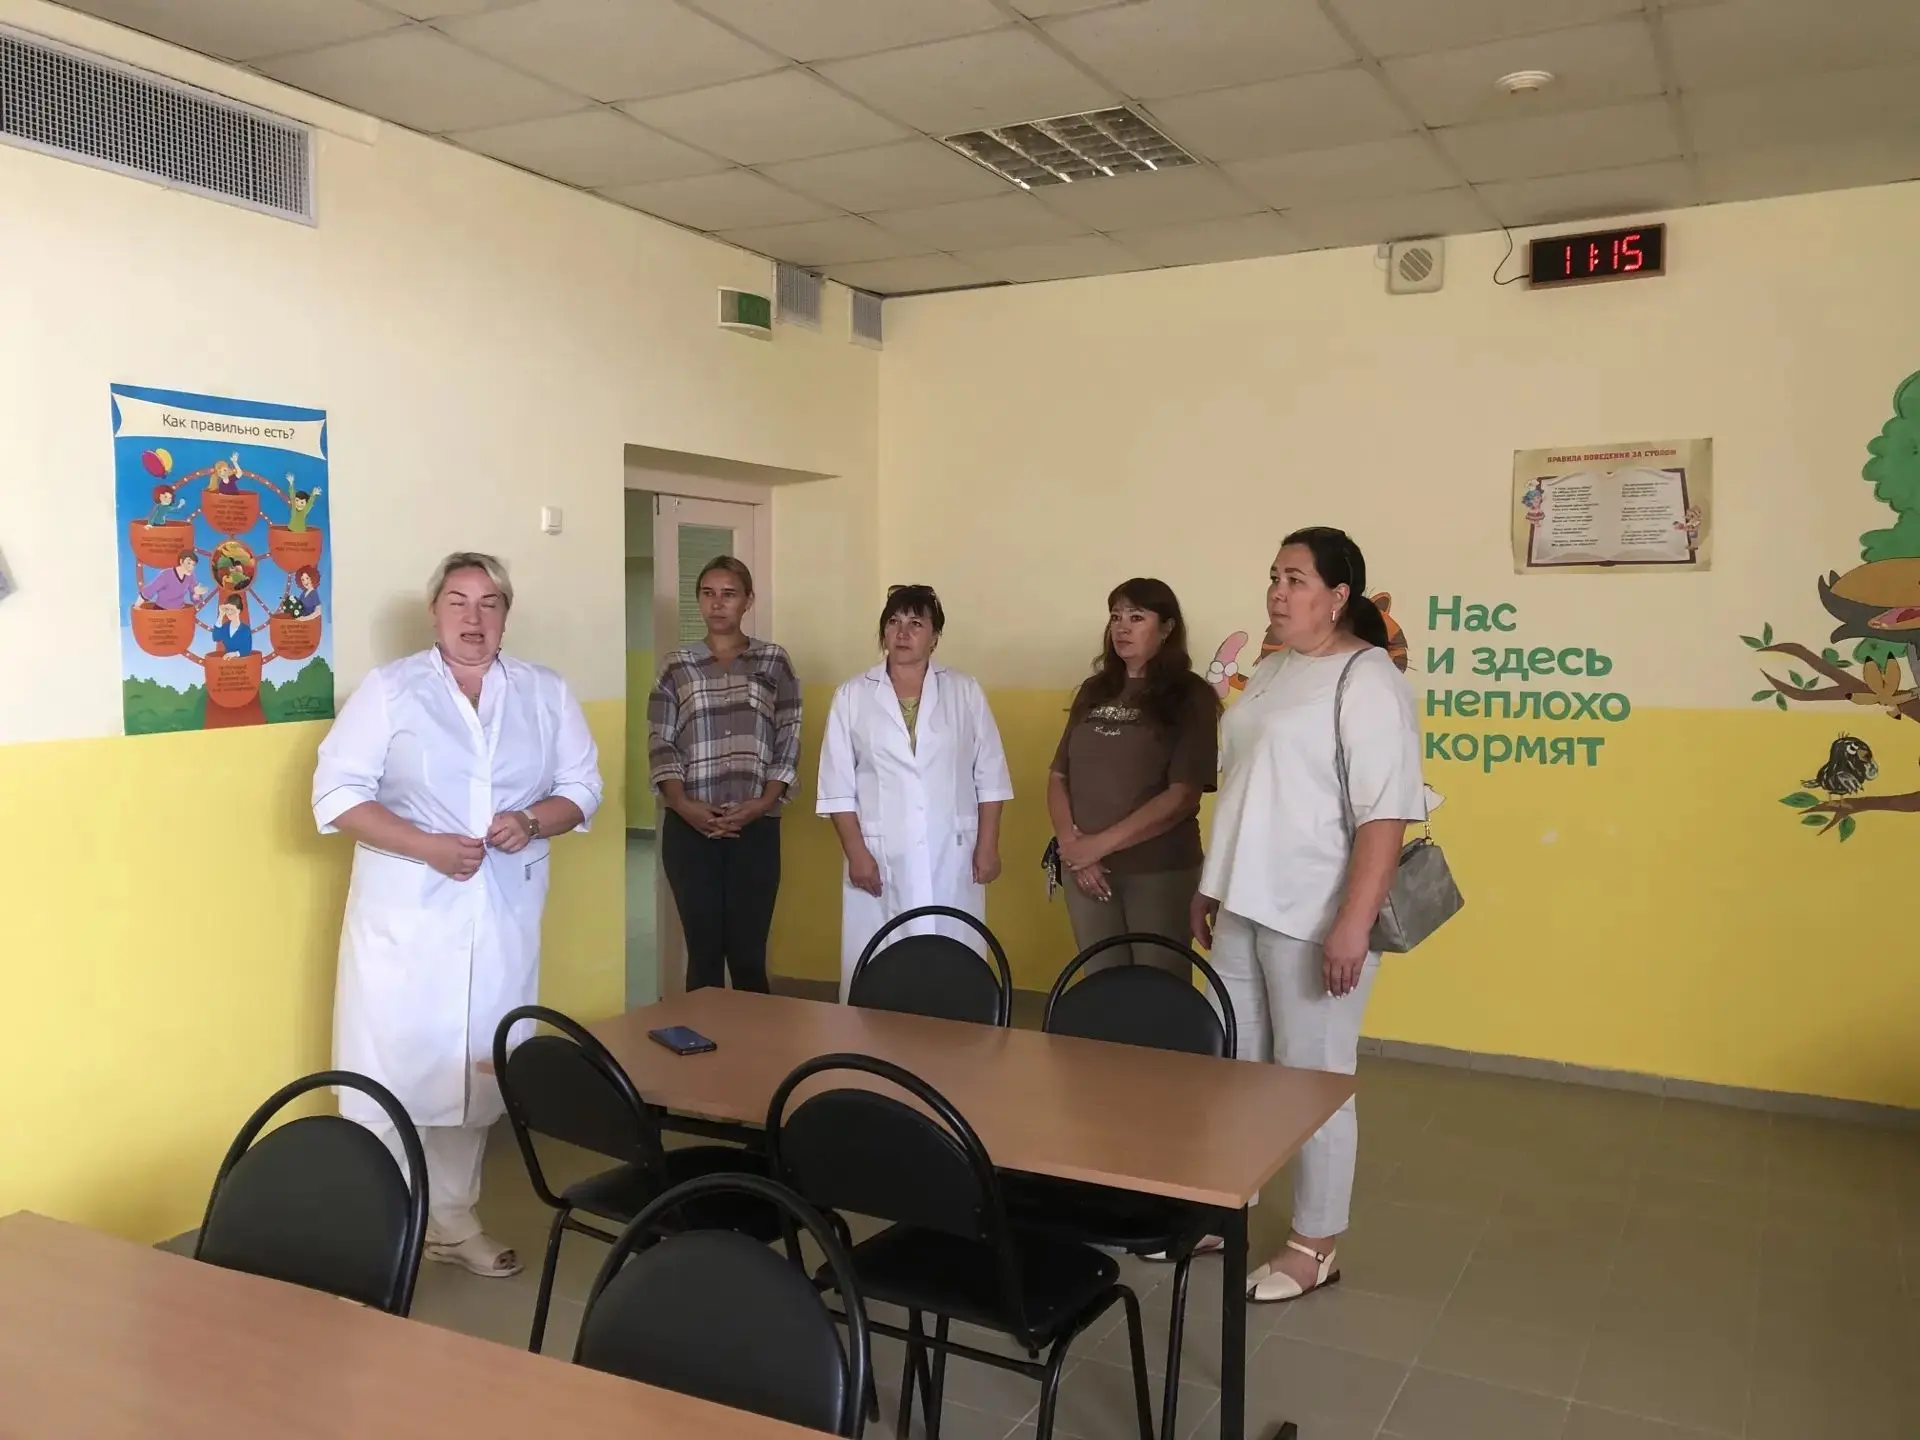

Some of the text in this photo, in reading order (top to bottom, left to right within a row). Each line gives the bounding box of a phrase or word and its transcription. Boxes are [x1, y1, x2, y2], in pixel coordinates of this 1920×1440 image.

[1565, 234, 1643, 275] 11:15
[162, 413, 295, 440] Как правильно есть?
[1428, 595, 1517, 632] Нас
[1427, 646, 1613, 681] и здесь
[1426, 689, 1631, 722] неплохо
[1425, 732, 1605, 773] кормят
